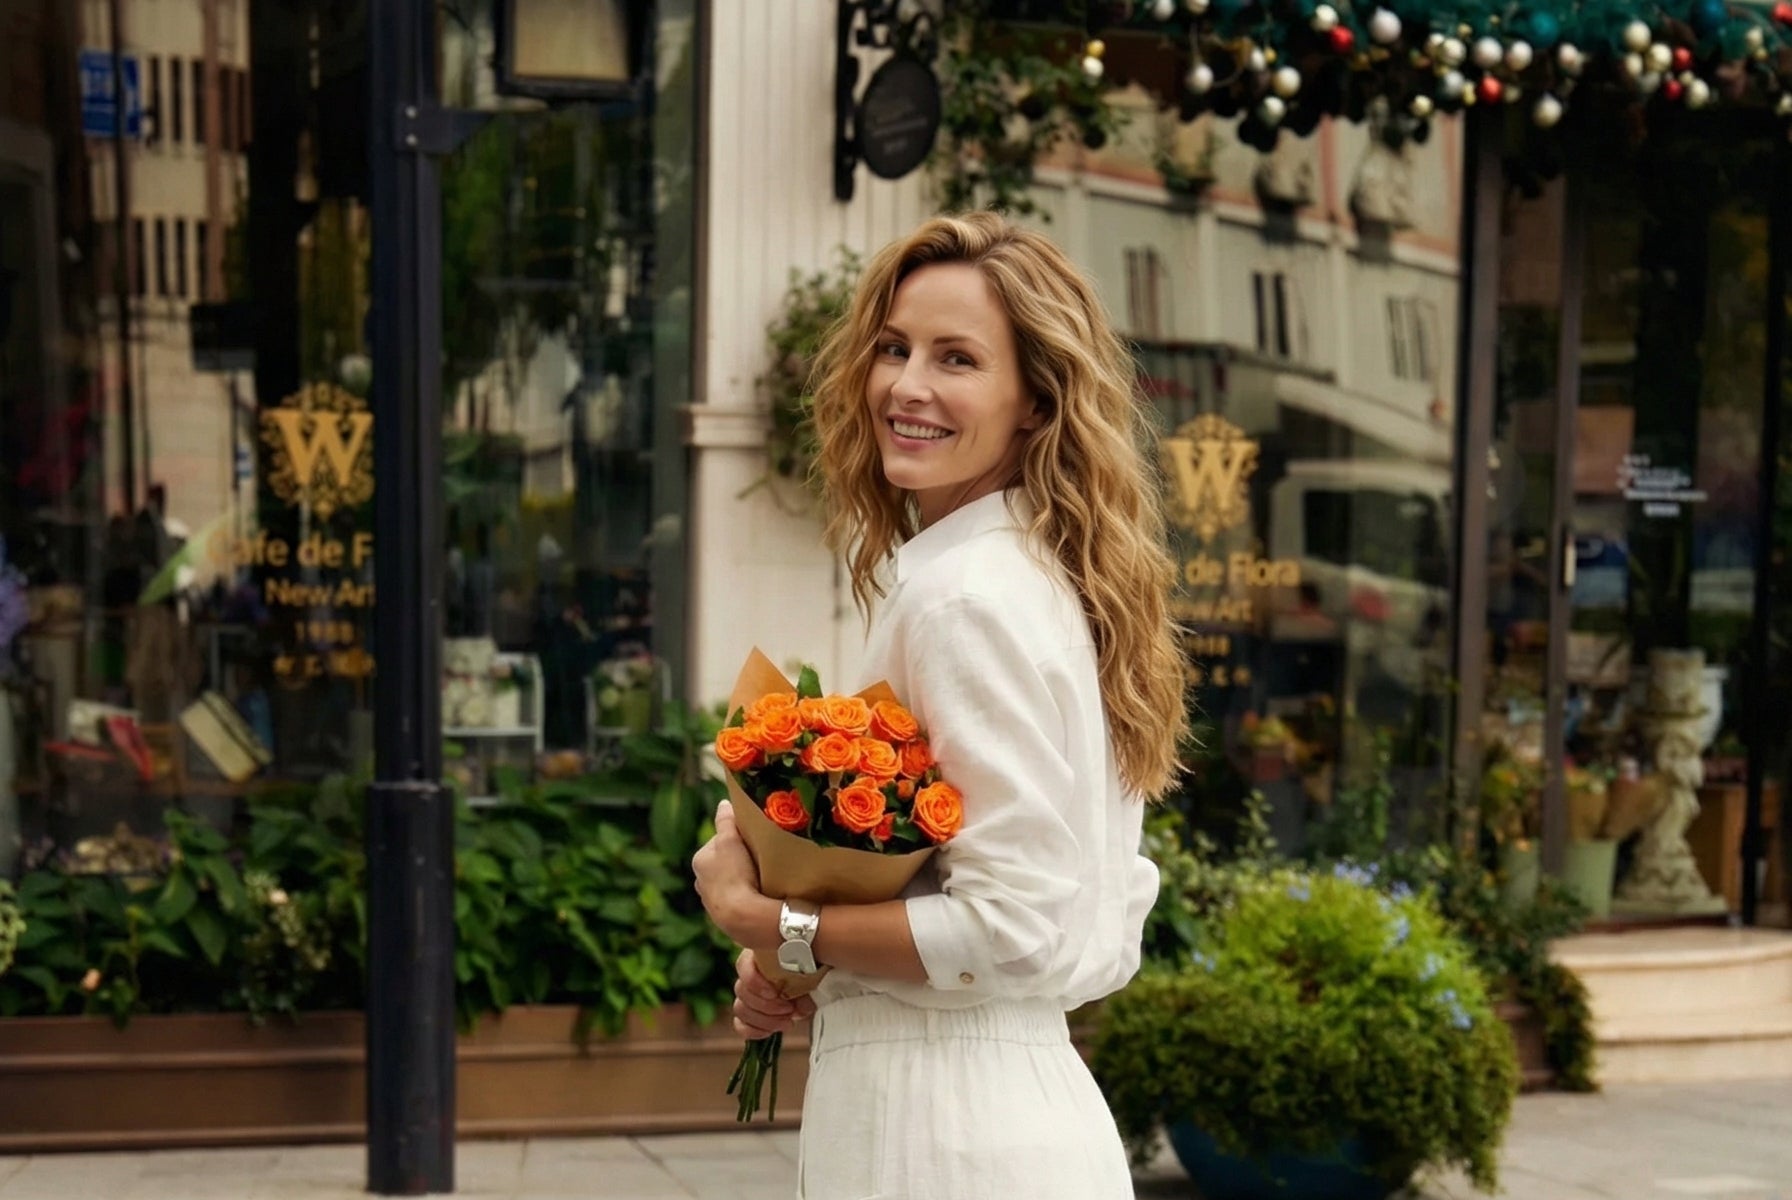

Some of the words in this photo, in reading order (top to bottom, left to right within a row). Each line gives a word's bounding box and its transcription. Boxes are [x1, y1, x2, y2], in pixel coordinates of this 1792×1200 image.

[260, 408, 374, 486] W
[1160, 438, 1258, 510] W
[297, 531, 345, 568] de
[352, 532, 374, 568] F
[1185, 553, 1223, 586] de
